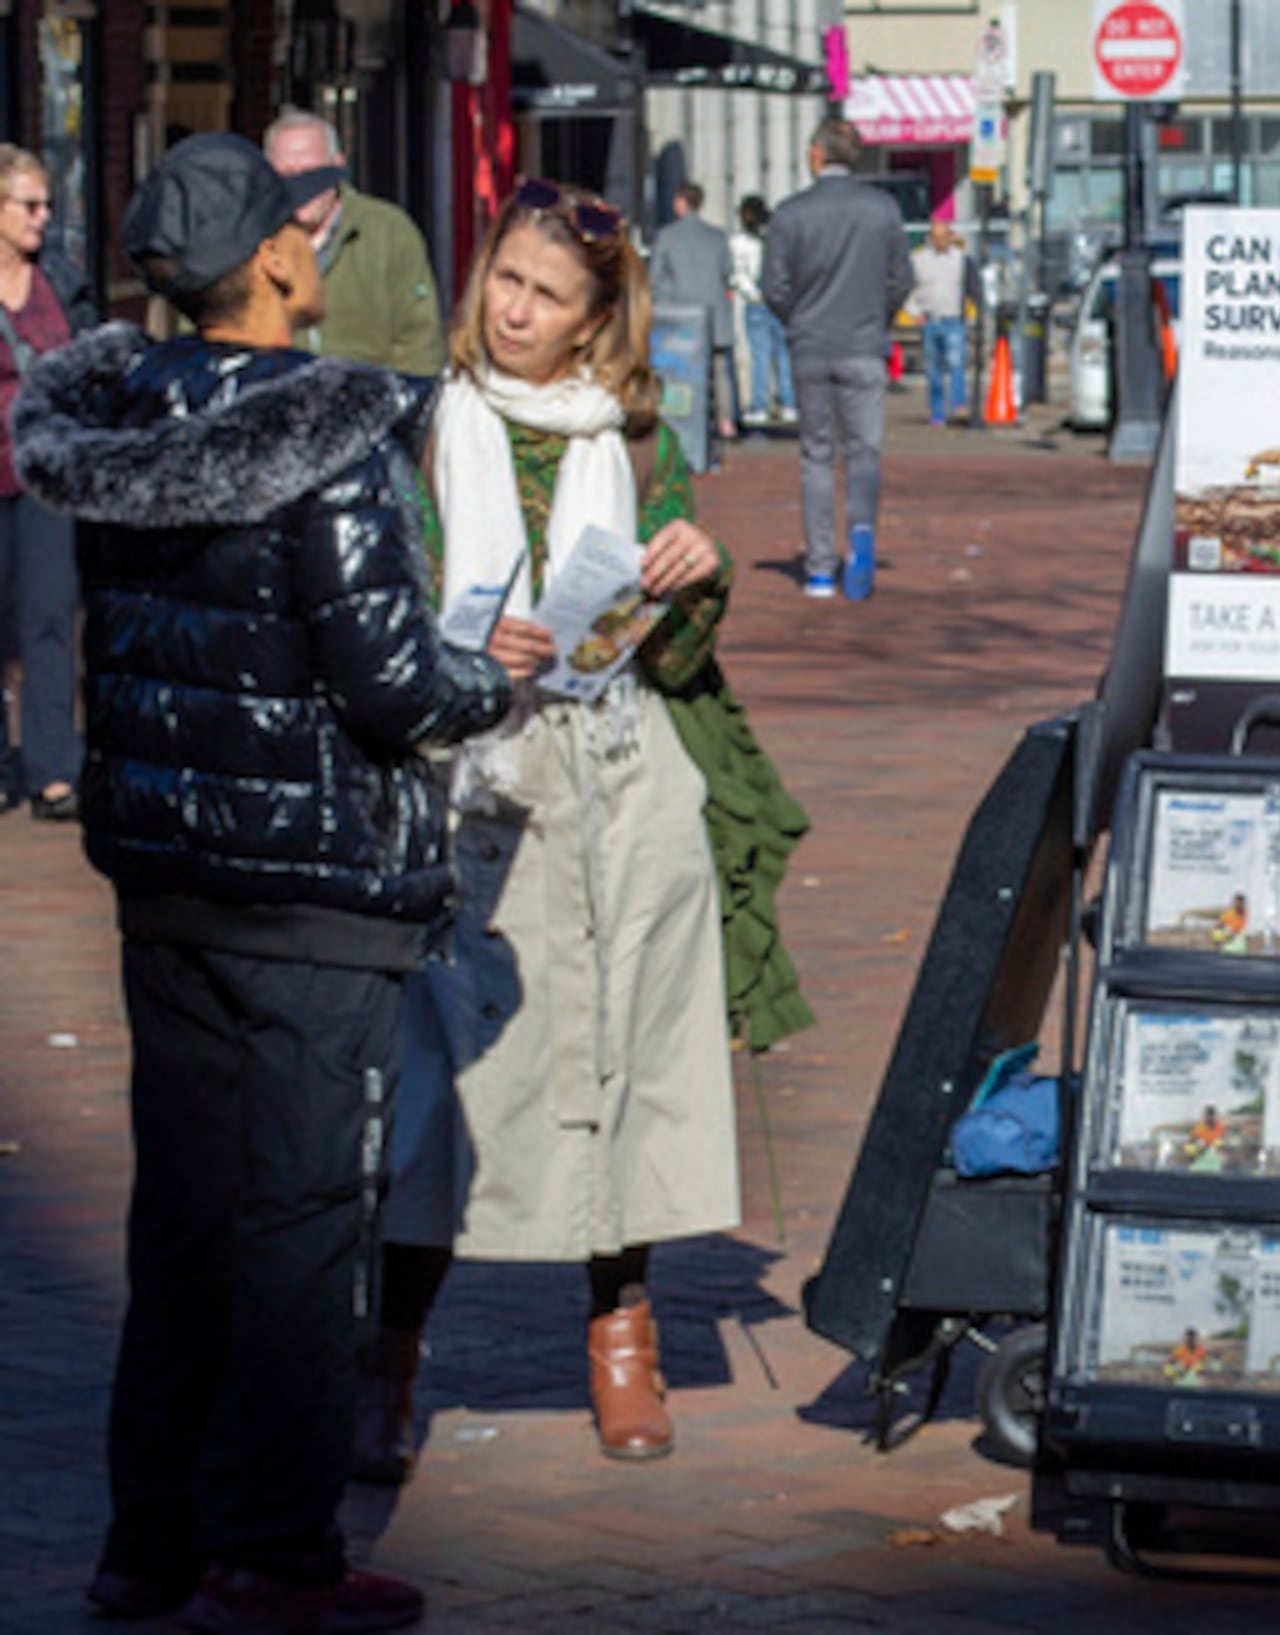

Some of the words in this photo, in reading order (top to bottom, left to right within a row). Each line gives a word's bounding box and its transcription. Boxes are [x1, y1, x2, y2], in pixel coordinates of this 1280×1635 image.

[1107, 18, 1128, 35] DO
[1137, 18, 1167, 35] NOT
[1113, 62, 1163, 79] ENTER
[1206, 235, 1271, 264] CAN
[1189, 602, 1251, 632] TAKE
[1257, 605, 1276, 632] A
